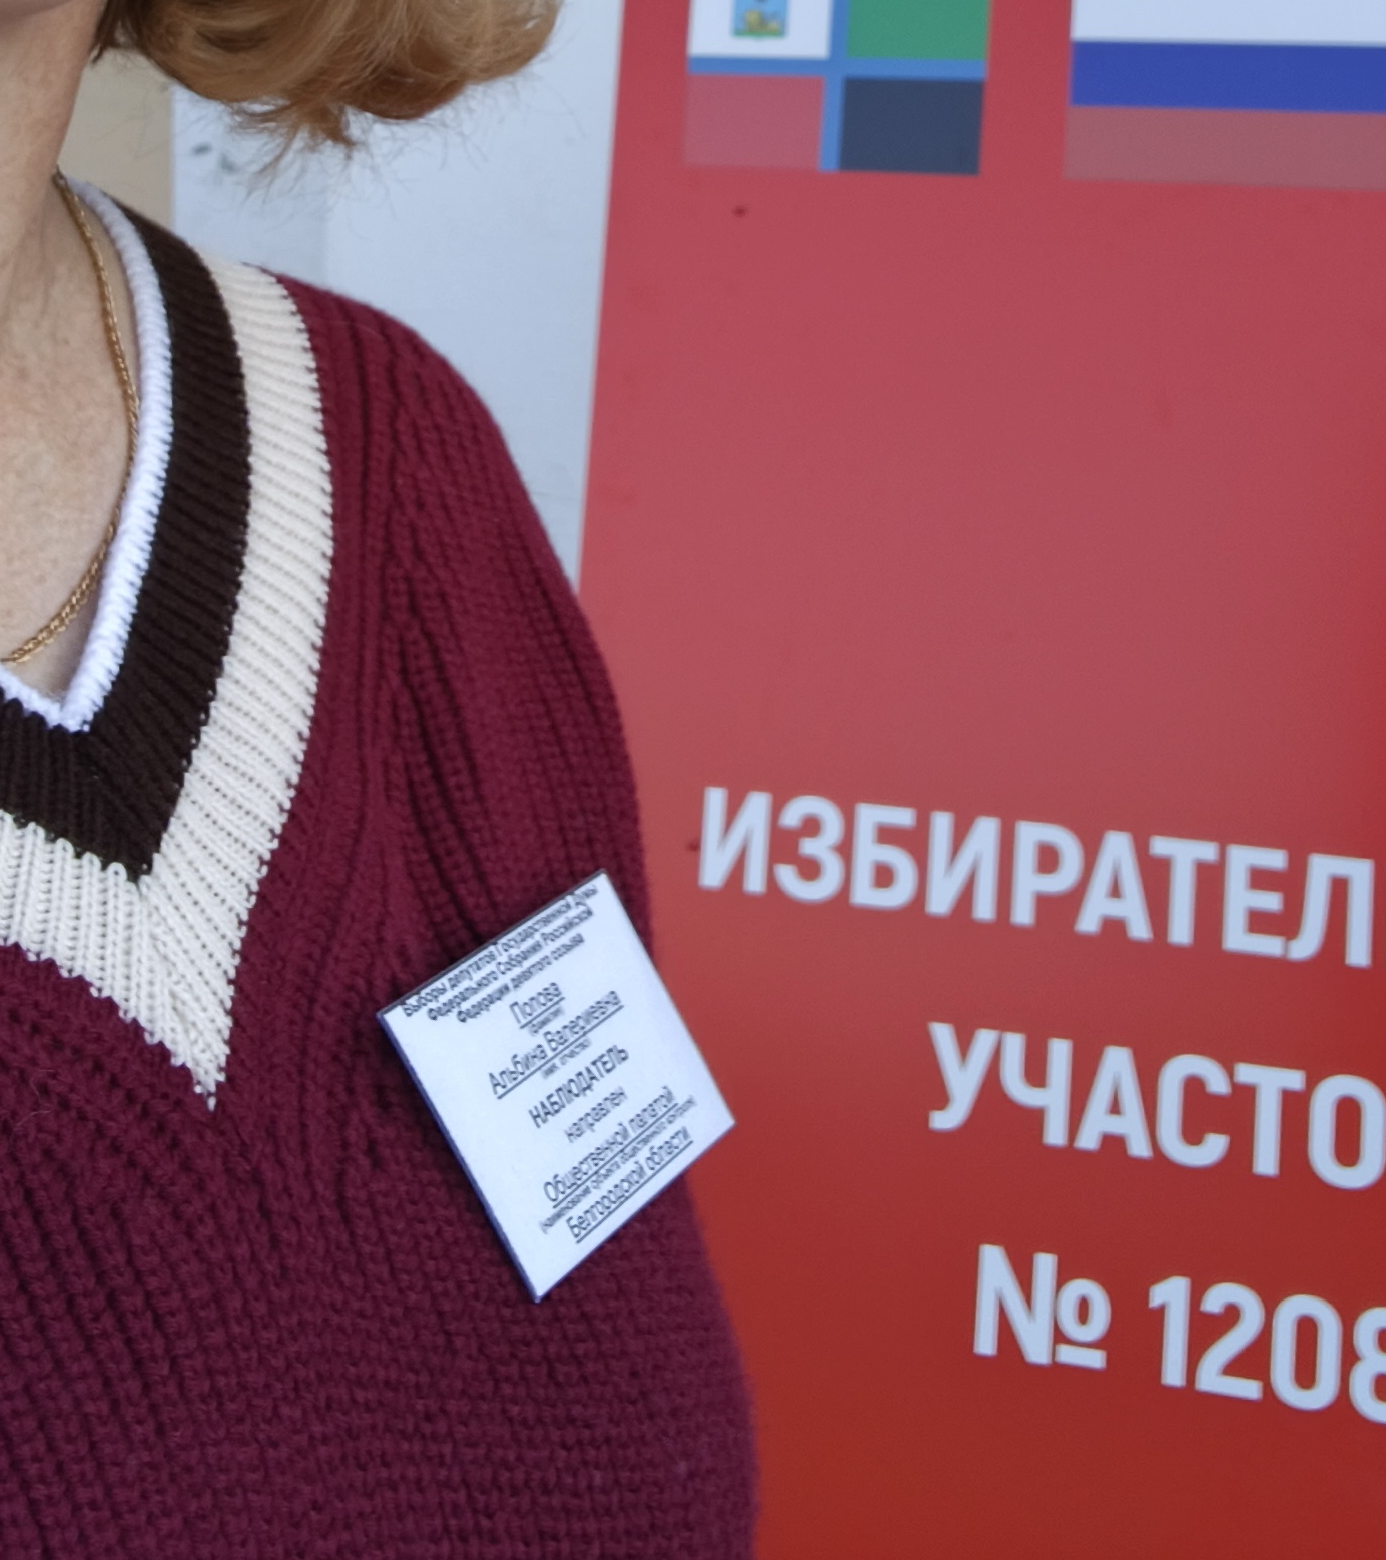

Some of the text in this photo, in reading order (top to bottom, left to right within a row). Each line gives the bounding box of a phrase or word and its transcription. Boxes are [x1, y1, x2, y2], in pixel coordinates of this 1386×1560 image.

[402, 980, 449, 1019] Выборы
[445, 948, 498, 991] депутатов
[493, 898, 573, 958] Государственной
[425, 967, 499, 1023] Федерального
[495, 937, 544, 978] Собрания
[485, 1037, 548, 1095] Альбина
[527, 1039, 631, 1132] НАБЛЮДАТЕЛЬ
[563, 1084, 629, 1147] направлен
[540, 1082, 676, 1206] Общественной палатой
[565, 1119, 691, 1241] Белгородской области
[972, 1243, 1111, 1369] №
